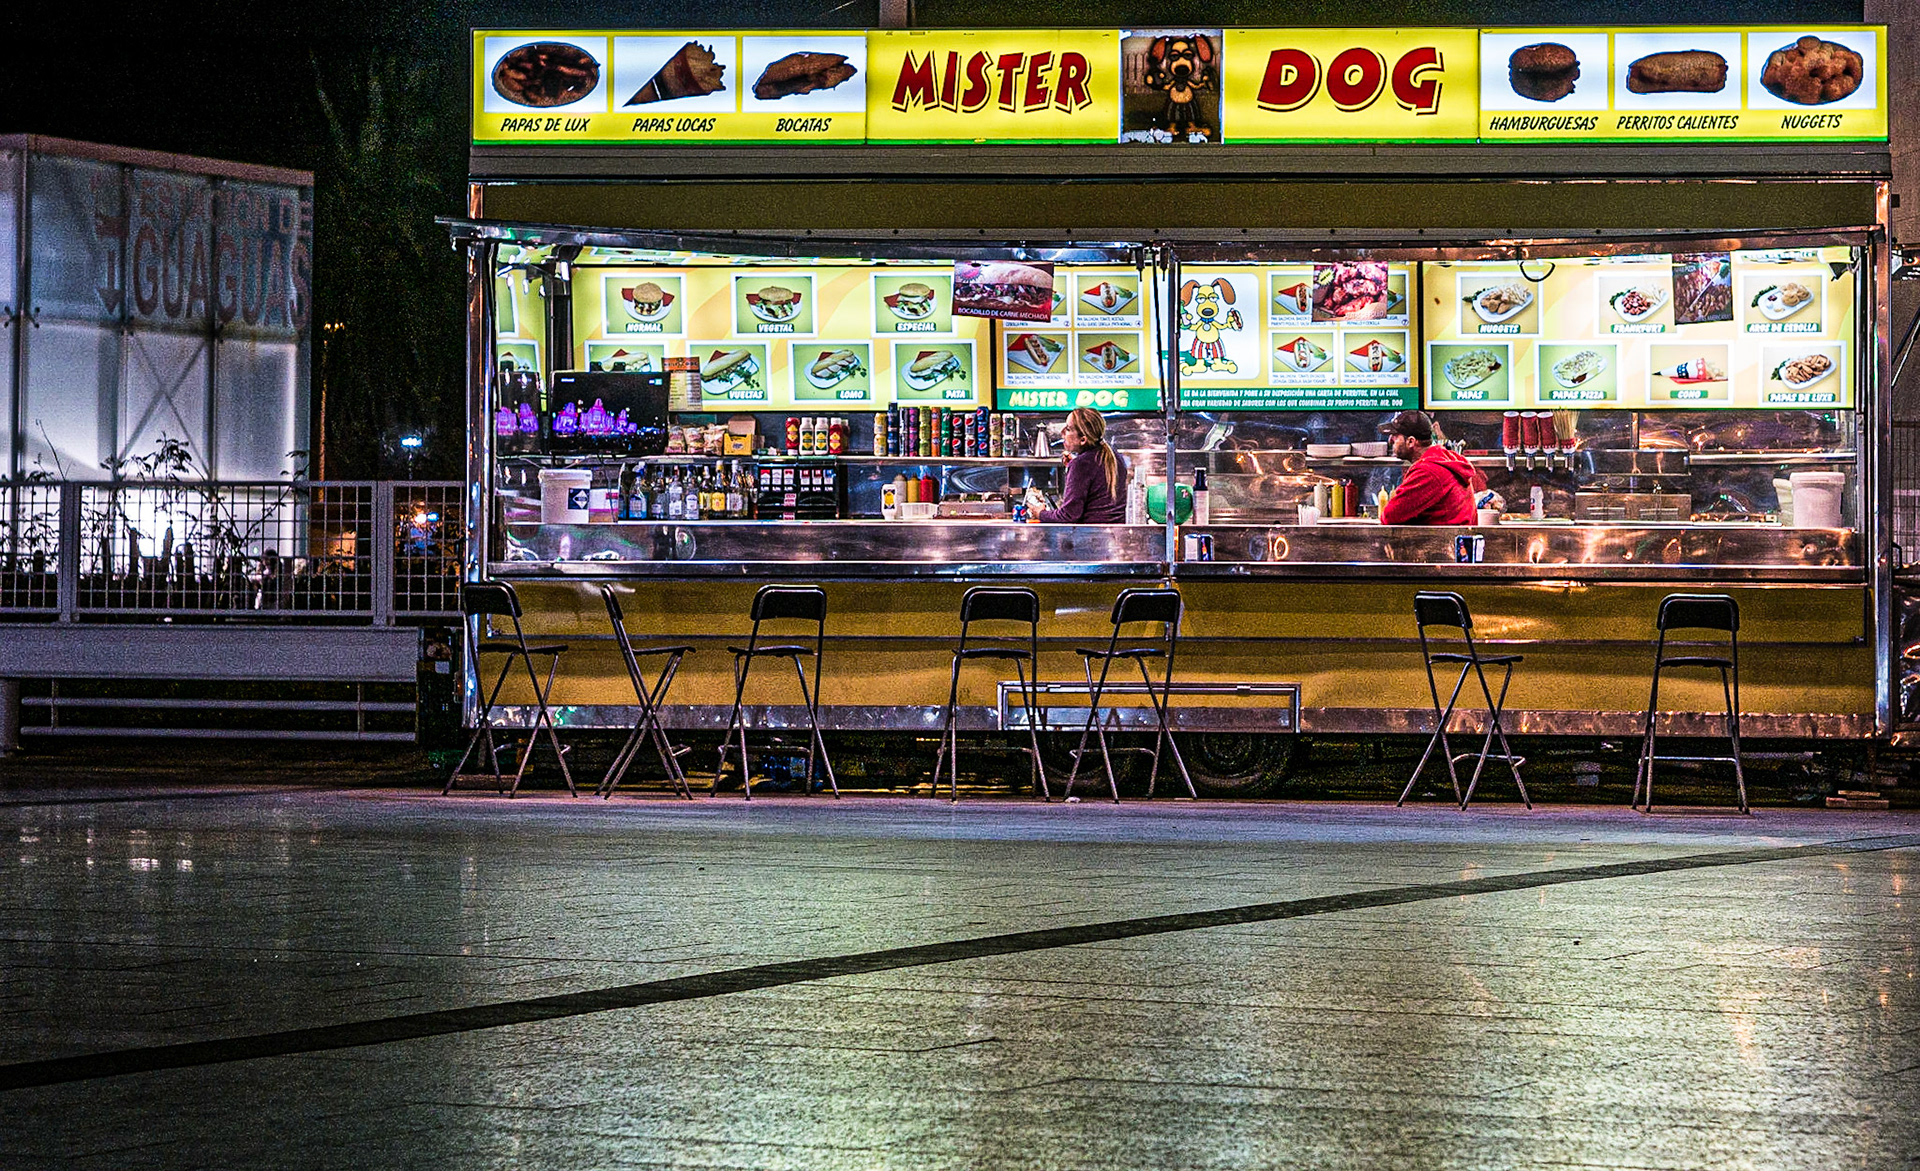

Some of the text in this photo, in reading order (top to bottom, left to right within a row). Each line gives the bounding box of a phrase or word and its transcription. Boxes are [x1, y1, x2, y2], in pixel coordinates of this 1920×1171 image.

[892, 47, 1445, 116] MISTER DOG
[500, 117, 591, 133] PAPAS DE LUX
[632, 117, 717, 132] PAPAS LOCAS
[775, 117, 832, 133] BOCATAS
[1489, 116, 1599, 132] HAMBURGUESAS
[1616, 115, 1739, 131] PERRITOS CALIENTES
[1781, 114, 1843, 130] NUGGETS
[279, 197, 312, 238] DE
[133, 224, 312, 331] GUAGUAS
[957, 307, 991, 316] BOCADILLO
[626, 323, 662, 332] NORMAL
[757, 323, 794, 332] VEGETAL
[896, 323, 936, 332] ESPECIAL
[1480, 325, 1519, 333] NUGGETS
[1613, 324, 1663, 333] FRANKFURT
[1748, 323, 1817, 332] AROS DE CEBOLLA
[729, 390, 764, 399] VUELTAS
[839, 390, 864, 399] LOMO
[945, 390, 966, 399] PATA
[1008, 390, 1129, 407] MISTER DOG
[1456, 391, 1483, 400] PAPAS
[1552, 391, 1604, 400] PAPAS PIZZA
[1677, 390, 1701, 399] CONO
[1769, 393, 1834, 402] PAPAS DE LUXE
[1207, 399, 1233, 407] VARIEDAD
[1335, 399, 1355, 407] PROPIO
